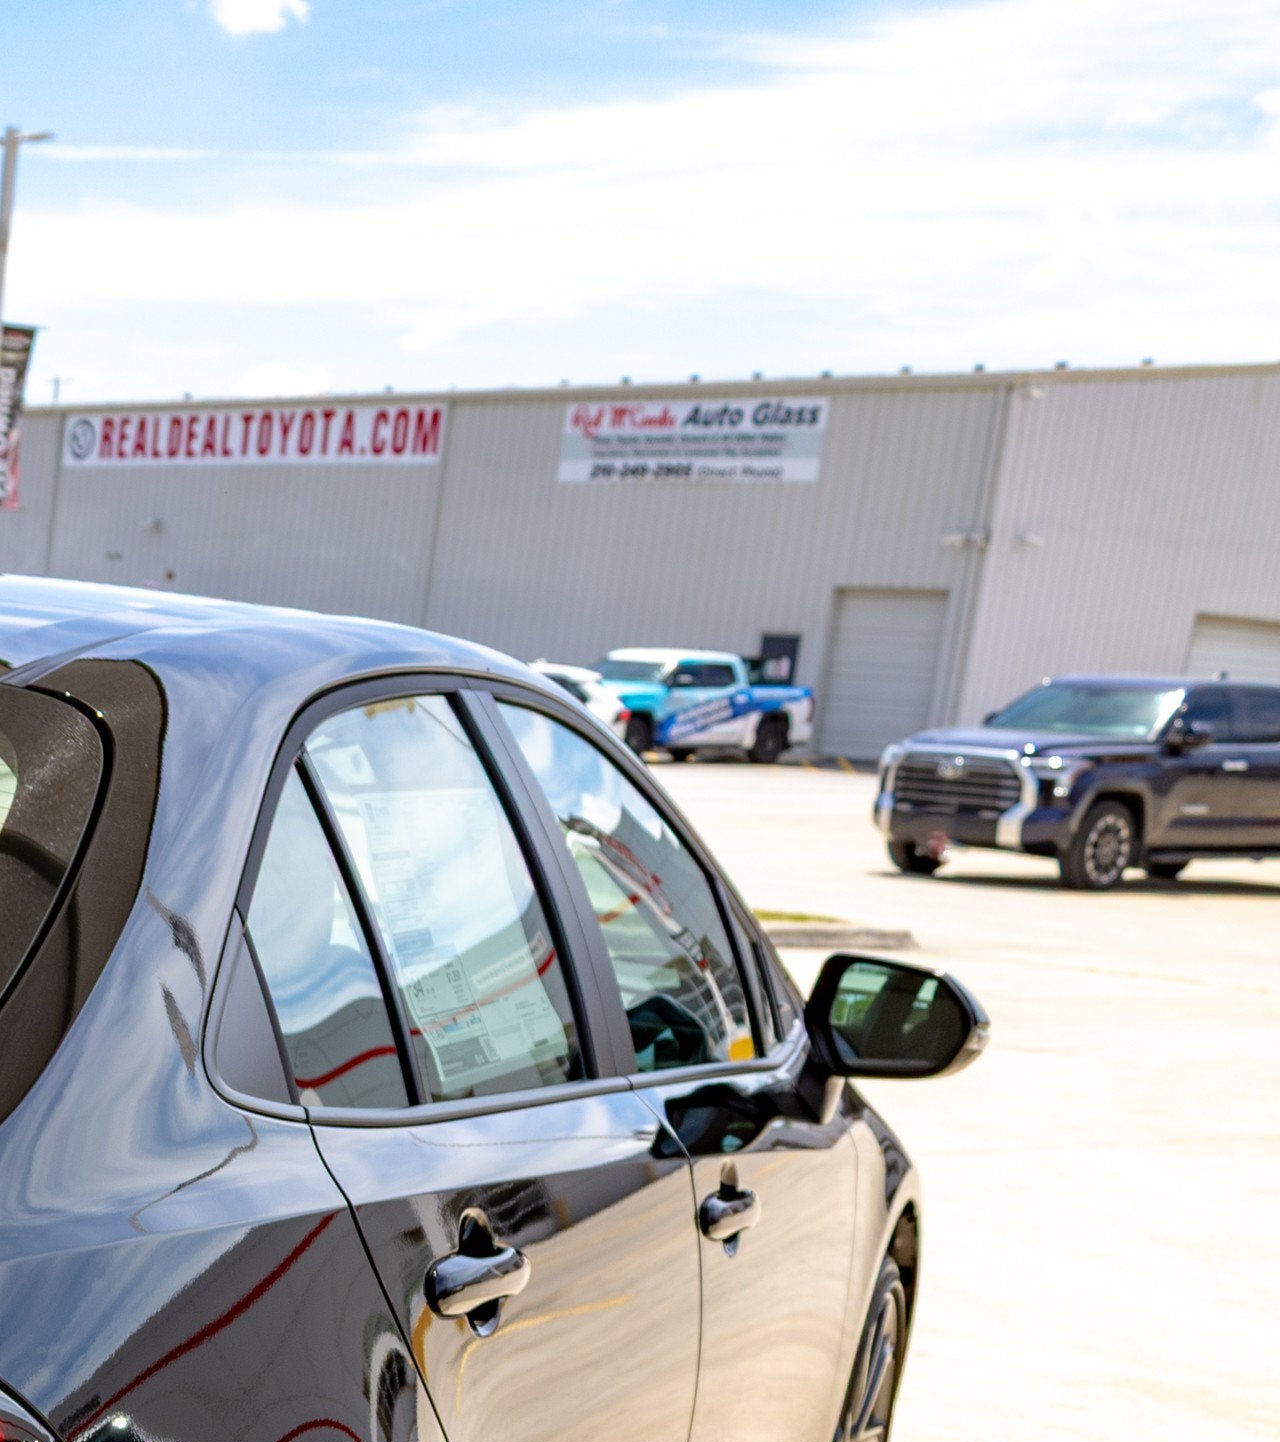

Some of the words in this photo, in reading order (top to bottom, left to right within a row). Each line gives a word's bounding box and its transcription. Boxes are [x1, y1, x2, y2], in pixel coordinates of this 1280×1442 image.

[681, 402, 744, 428] Auto
[752, 399, 822, 428] Glass
[98, 408, 441, 460] REALDEALTOYOTA.COM
